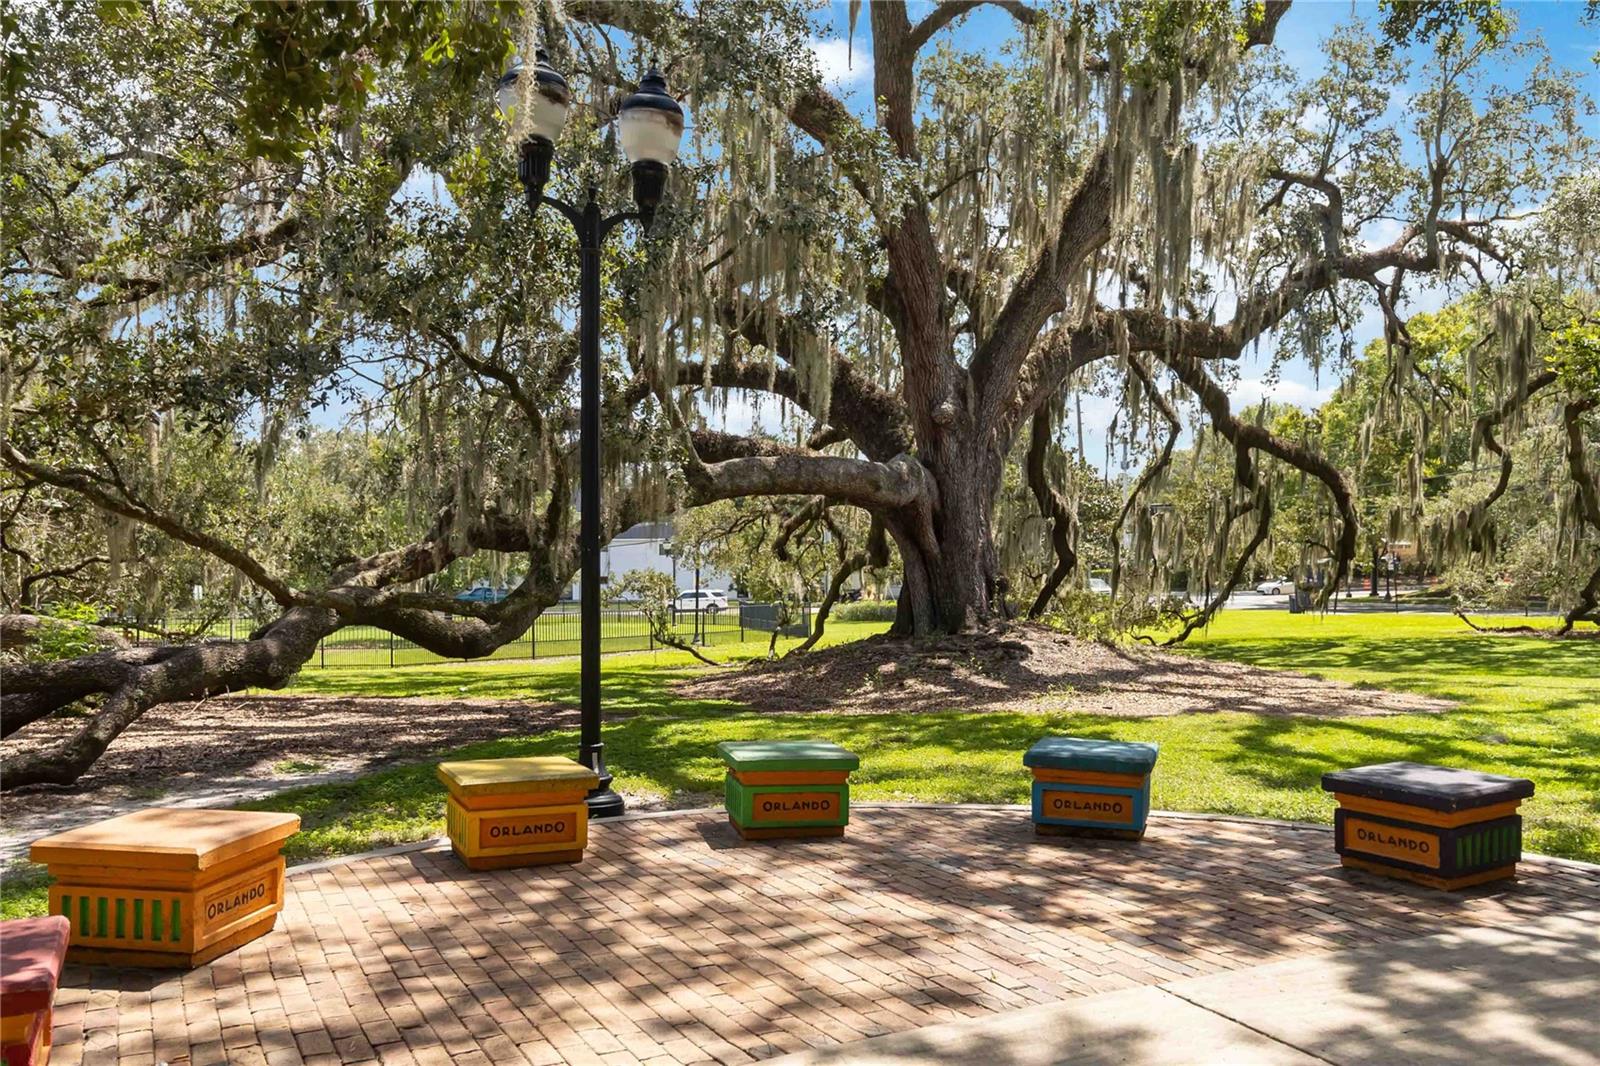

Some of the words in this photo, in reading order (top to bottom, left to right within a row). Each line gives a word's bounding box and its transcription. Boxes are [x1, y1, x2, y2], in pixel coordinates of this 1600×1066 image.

[762, 800, 830, 812] ORLANDO
[1053, 799, 1123, 814] ORLANDO
[490, 821, 566, 838] ORLANDO
[1356, 828, 1430, 853] ORLANDO
[207, 883, 265, 920] ORLANDO
